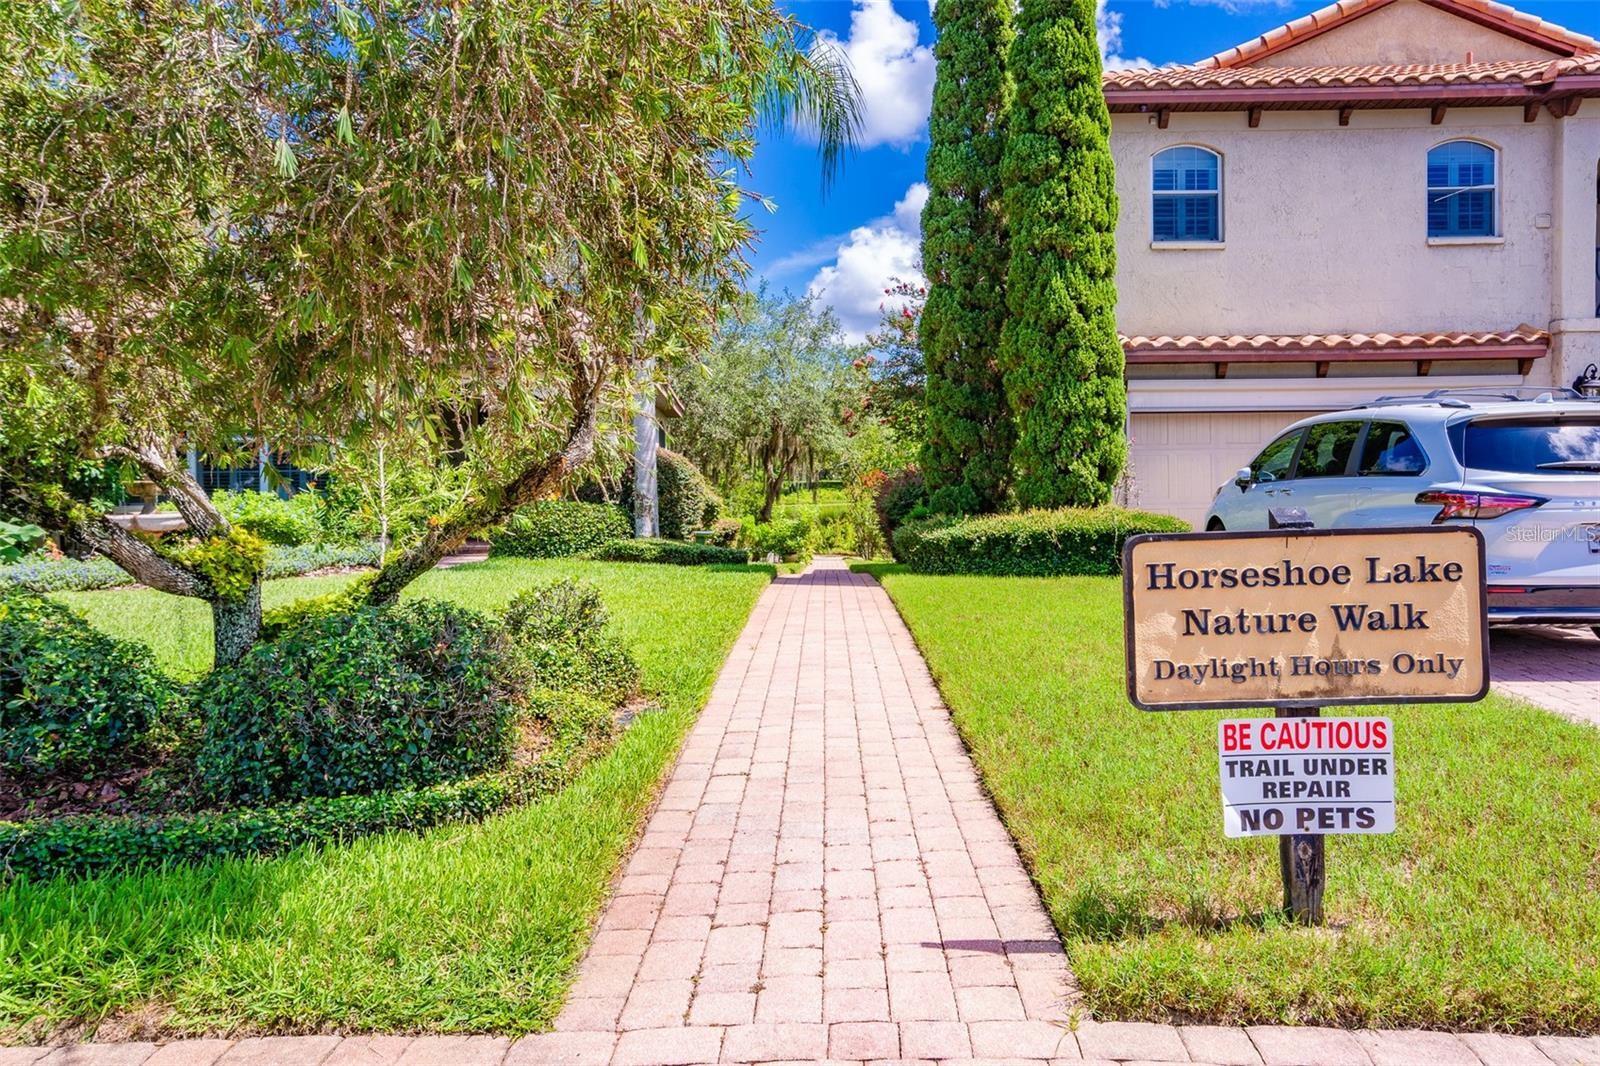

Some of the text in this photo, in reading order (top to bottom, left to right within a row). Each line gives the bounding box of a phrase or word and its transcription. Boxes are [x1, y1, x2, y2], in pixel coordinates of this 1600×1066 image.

[1146, 556, 1463, 590] Horseshoe Lake
[1182, 603, 1429, 636] Nature Walk
[1153, 652, 1464, 685] Daylight Hours Only
[1223, 721, 1387, 751] BE CAUTIOUS
[1225, 758, 1388, 778] TRAIL UNDER
[1262, 781, 1351, 799] REPAIR
[1240, 807, 1376, 832] NO PETS
